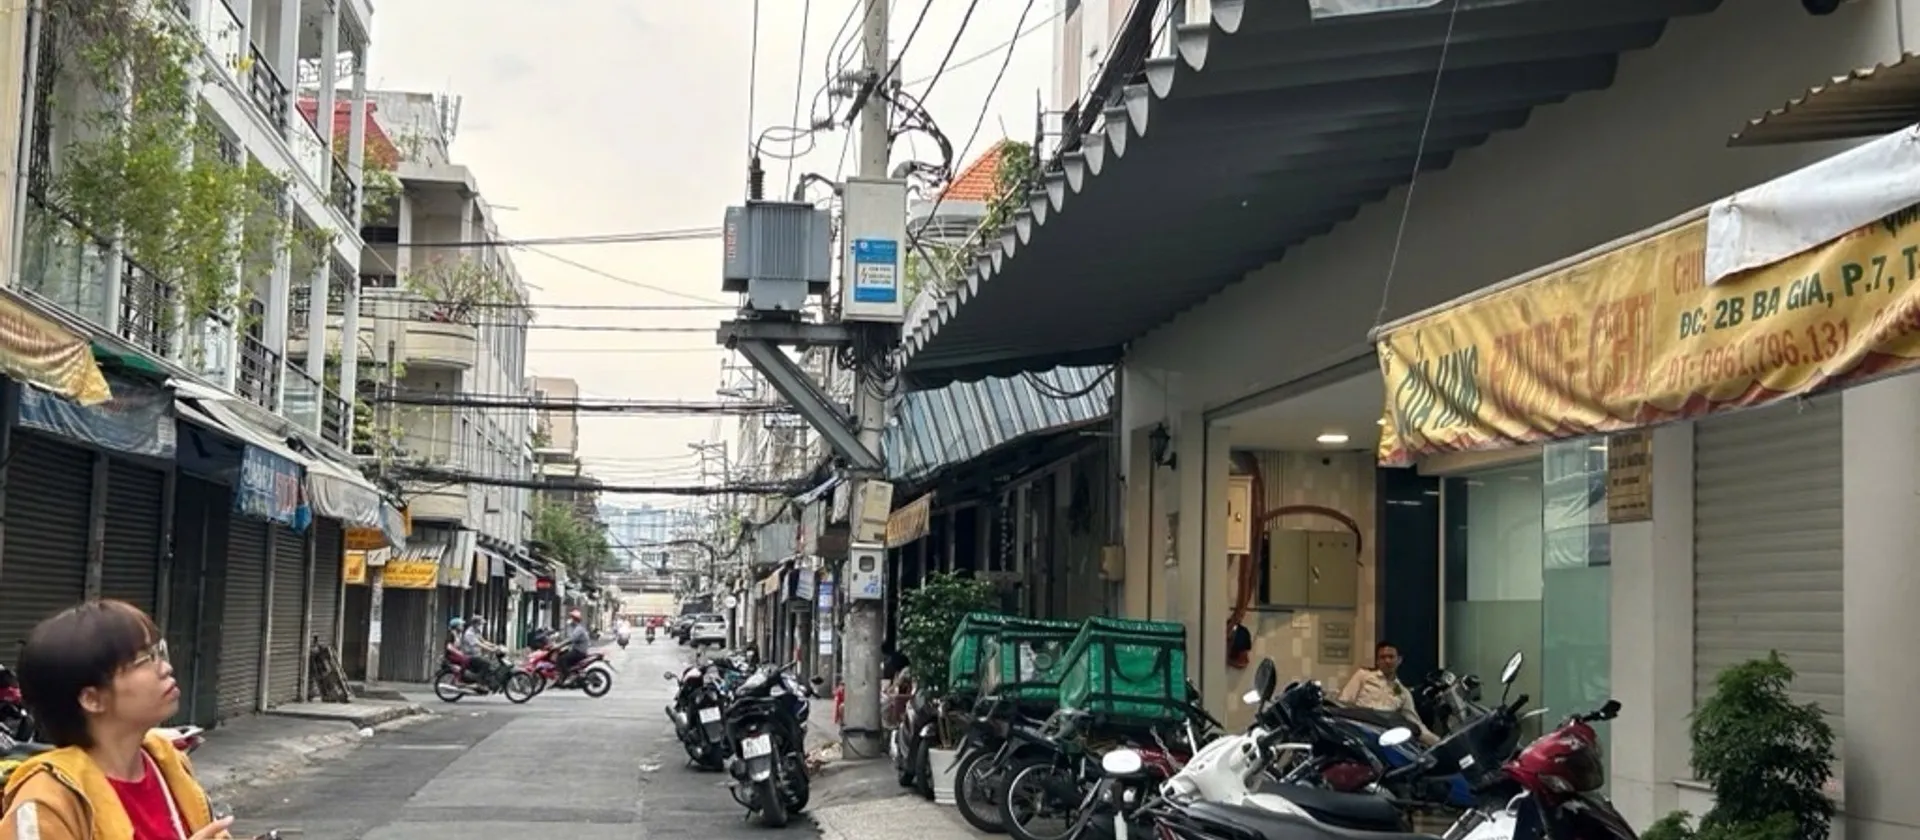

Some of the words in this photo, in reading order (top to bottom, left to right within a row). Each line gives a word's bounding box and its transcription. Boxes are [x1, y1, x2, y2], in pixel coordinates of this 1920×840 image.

[1680, 306, 1707, 340] ĐC:
[1714, 297, 1744, 330] 2B
[1751, 286, 1780, 321] BA
[1786, 272, 1834, 309] GIA,
[1842, 254, 1896, 297] P.7,
